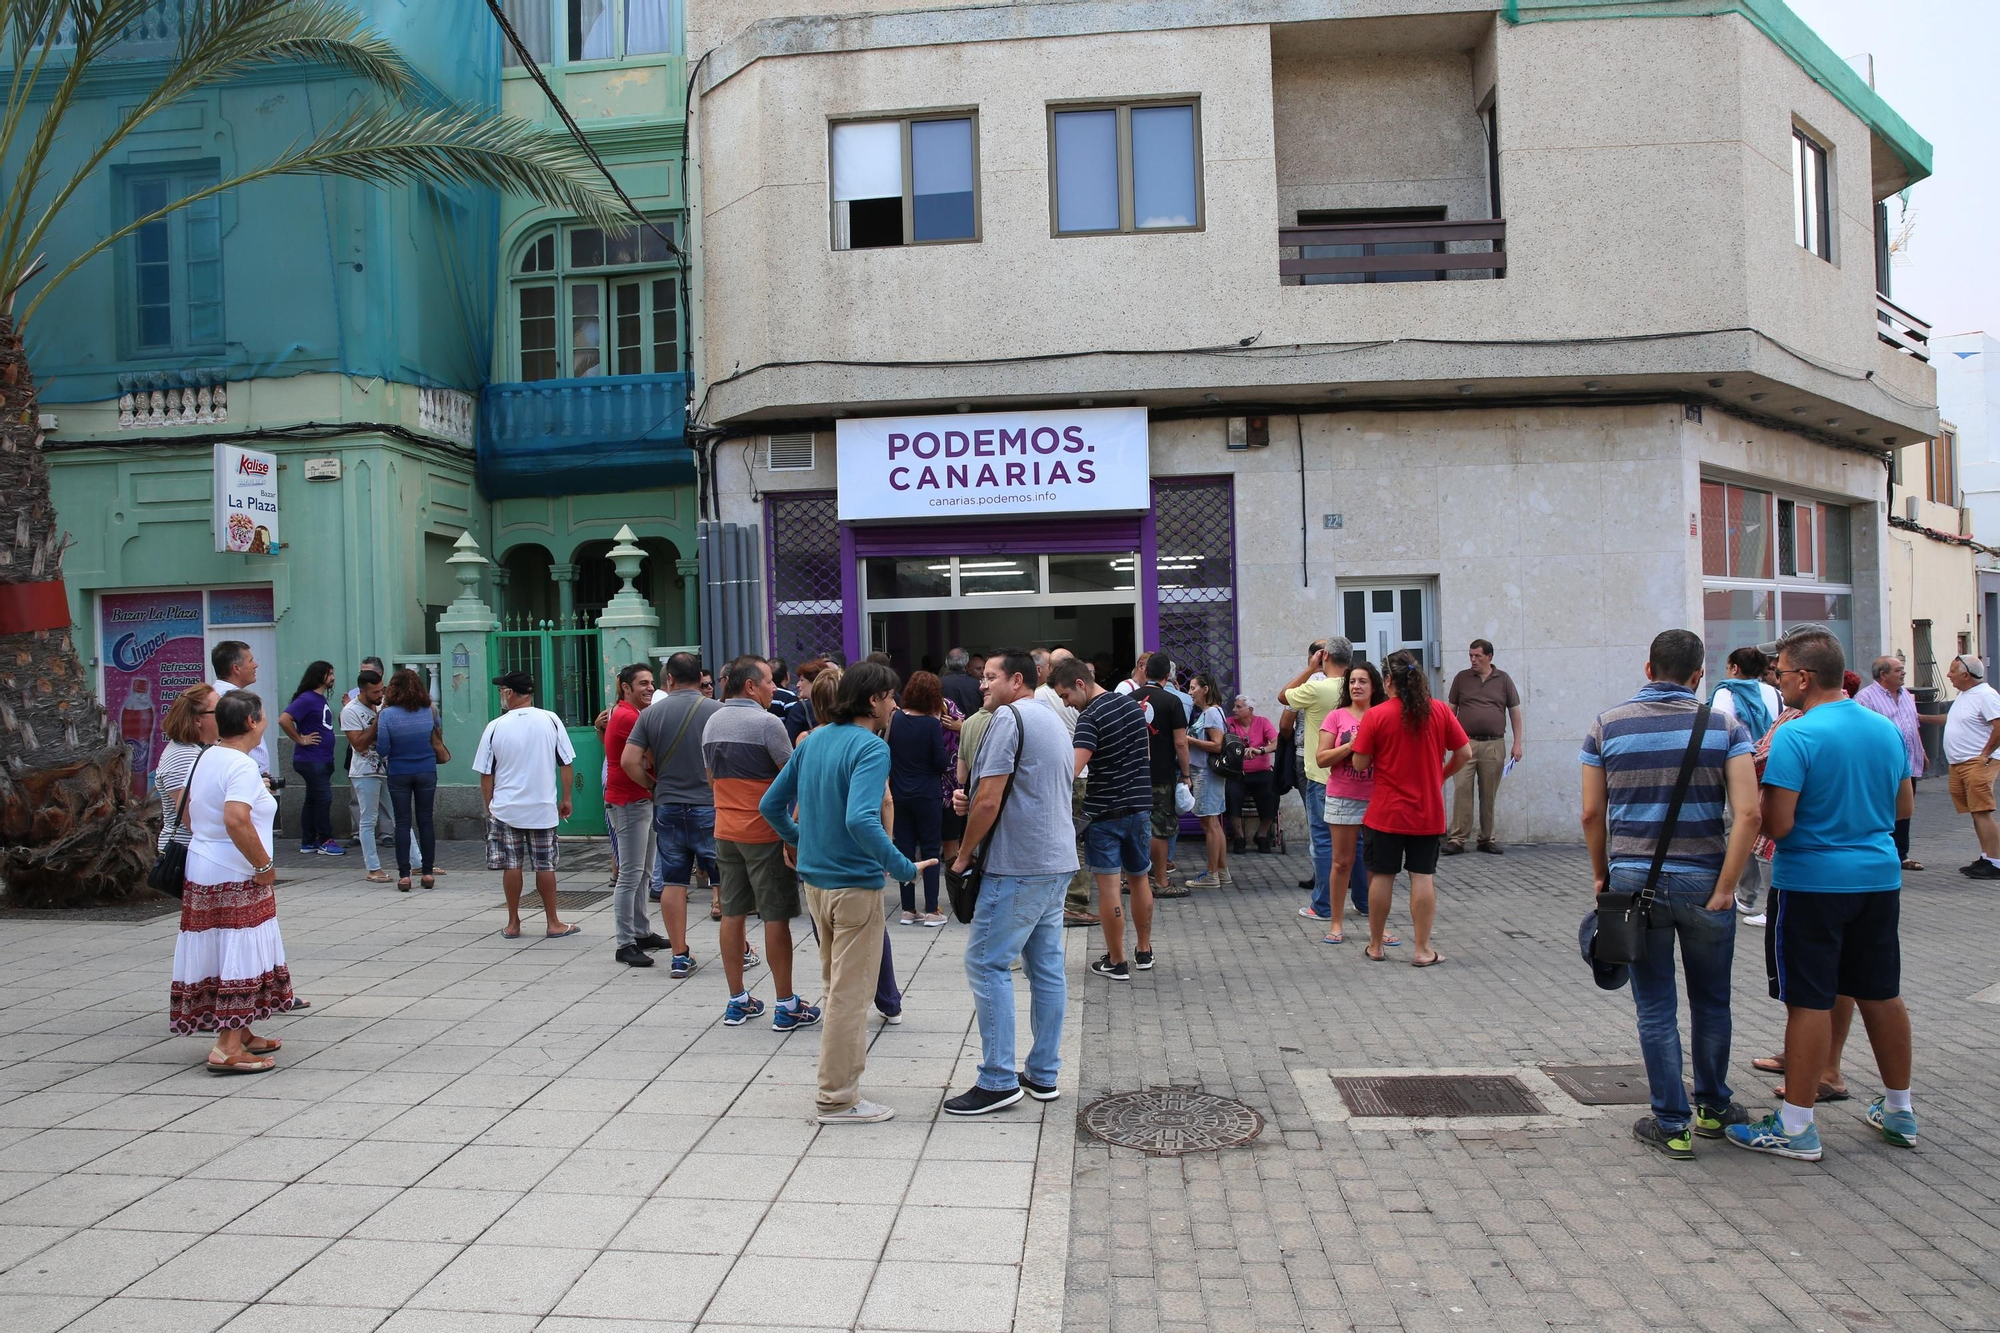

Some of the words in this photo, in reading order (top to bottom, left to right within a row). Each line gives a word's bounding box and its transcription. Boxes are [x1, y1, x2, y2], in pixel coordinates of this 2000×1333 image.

[888, 425, 1095, 460] PODEMOS.
[239, 454, 269, 475] Kalise
[889, 459, 1096, 491] CANARIAS
[260, 490, 276, 498] Bazar
[929, 491, 1057, 507] canarias.podemos.info
[228, 494, 243, 508] La
[247, 496, 276, 513] Plaza
[112, 608, 147, 622] Bazar
[148, 606, 164, 620] La
[166, 605, 198, 619] Plaza
[112, 631, 167, 673] Clipper
[160, 662, 202, 672] Refrescos
[160, 676, 201, 686] Golosinas
[161, 690, 183, 701] Hela
